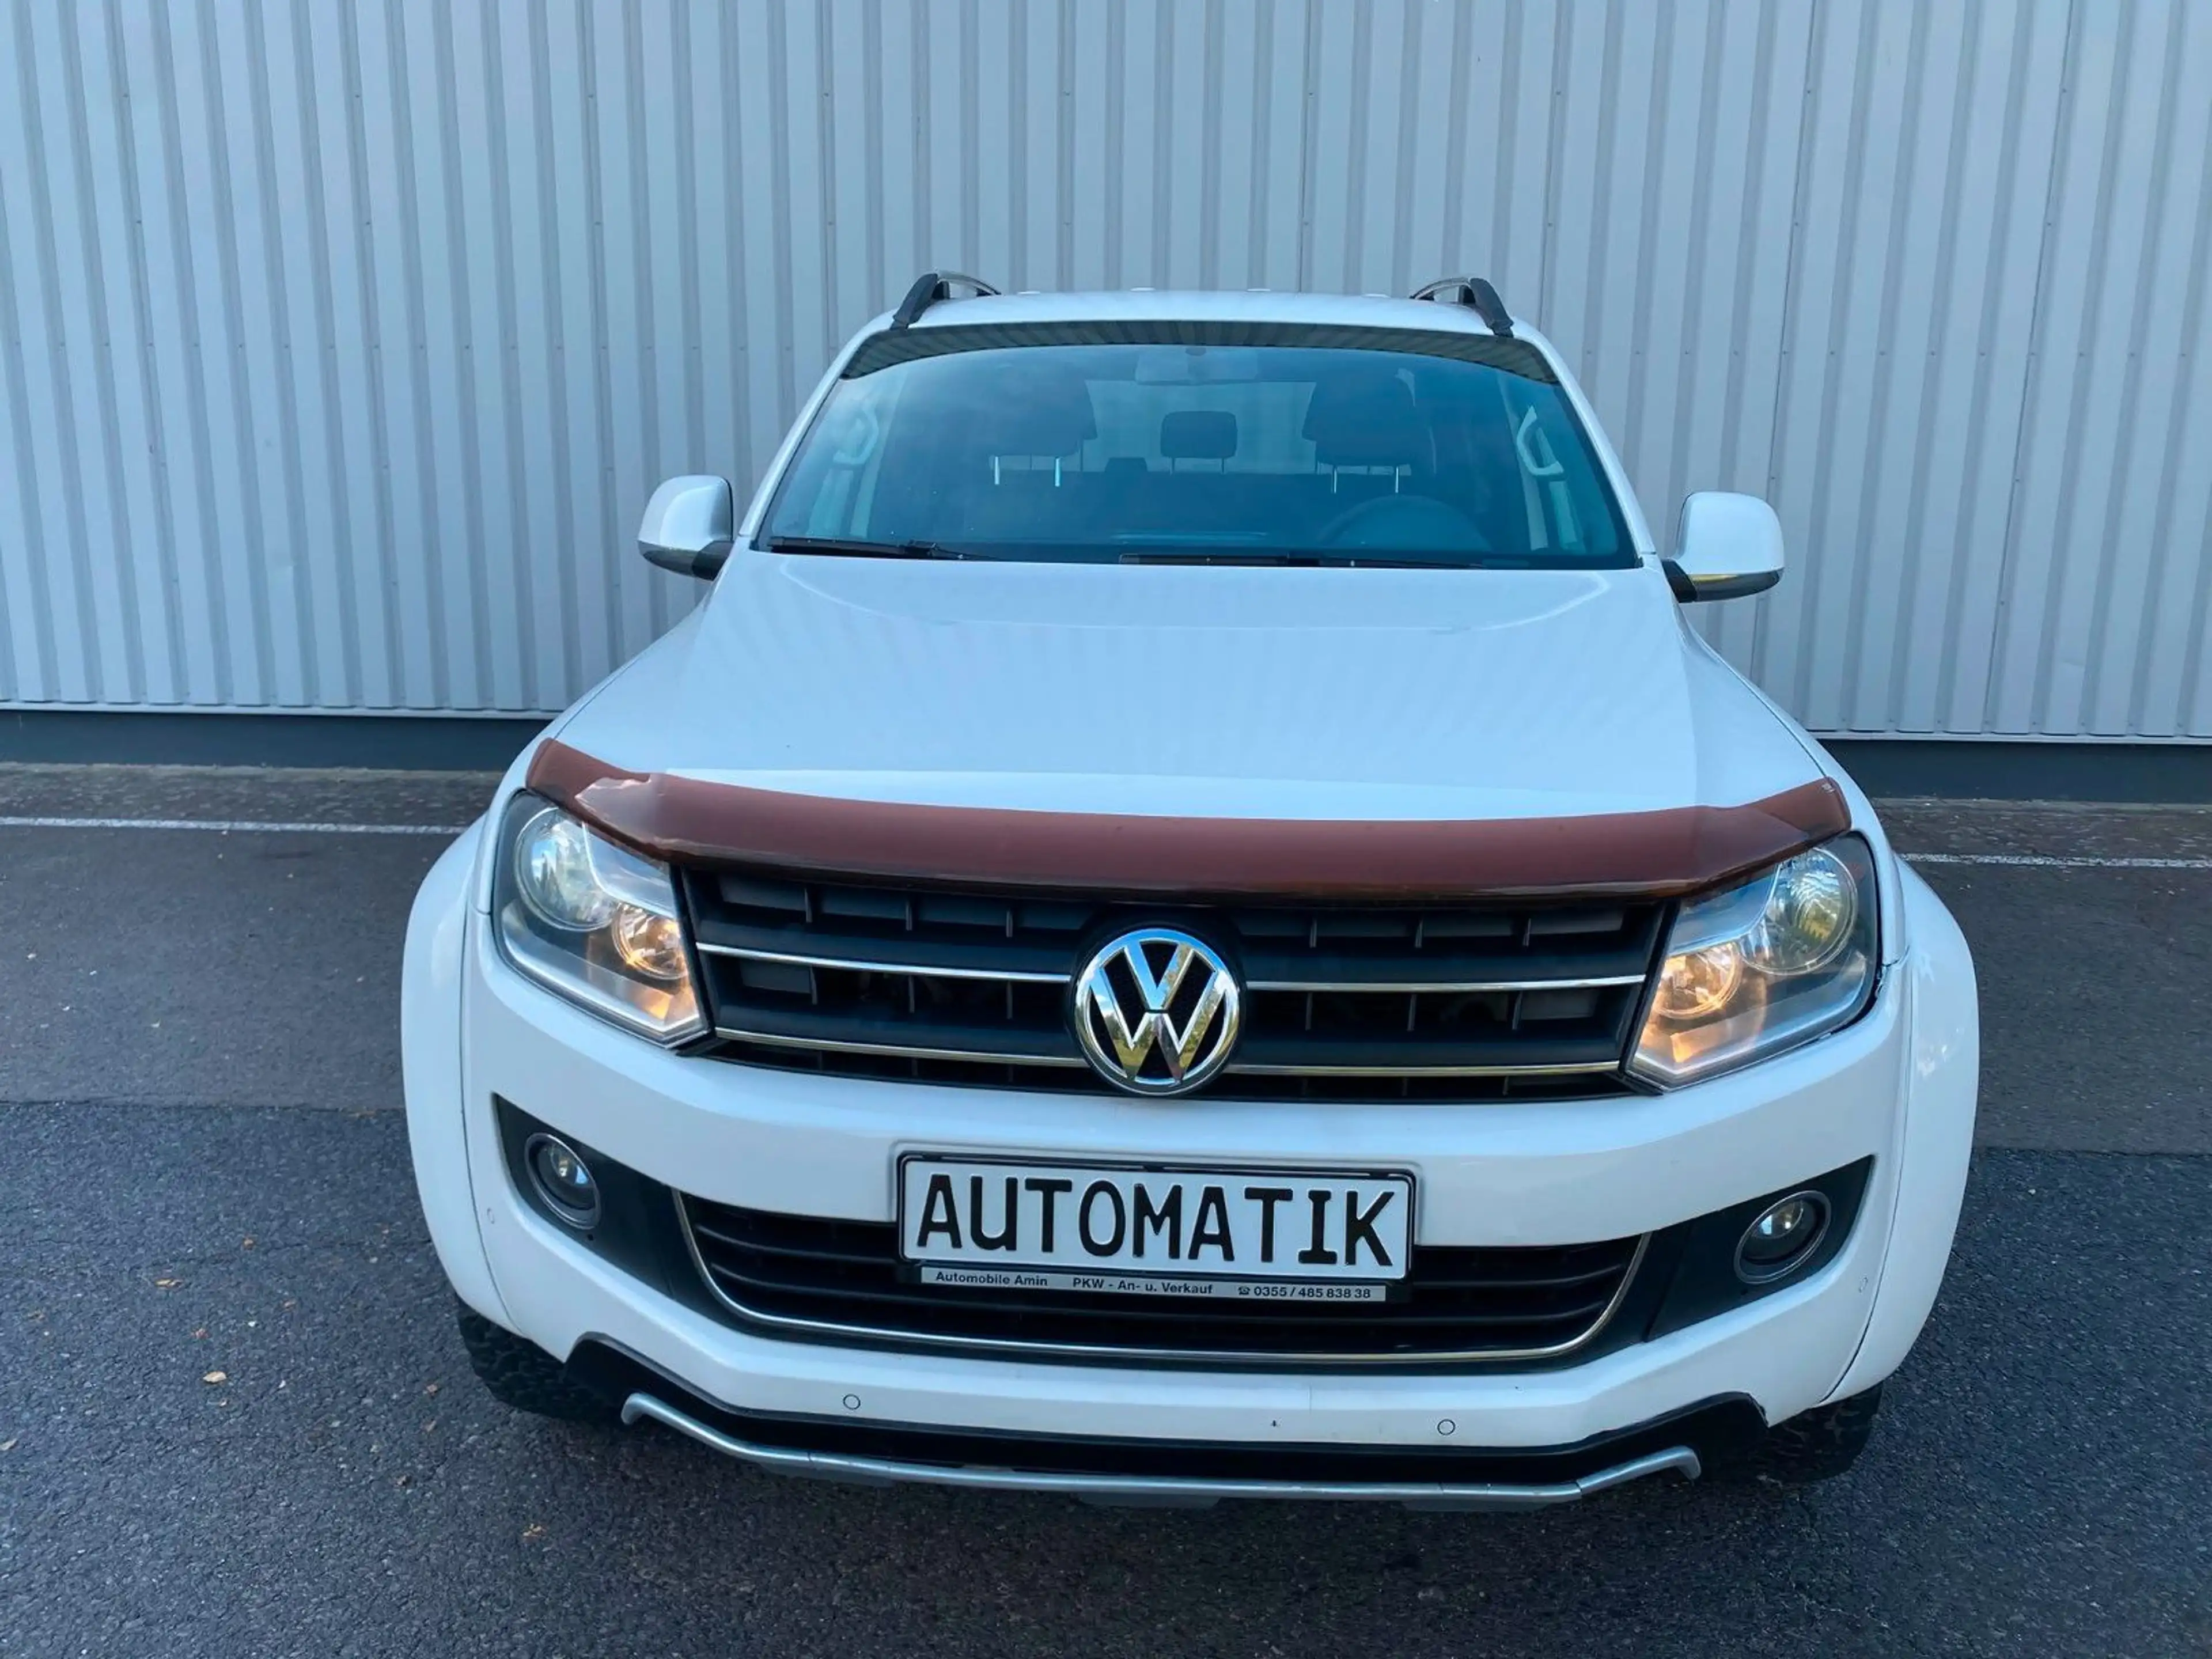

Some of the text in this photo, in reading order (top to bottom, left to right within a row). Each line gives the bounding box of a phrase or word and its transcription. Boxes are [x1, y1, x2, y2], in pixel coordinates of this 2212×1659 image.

[1081, 932, 1234, 1090] VW
[917, 1174, 1395, 1266] AUTOMATIK
[935, 1271, 1010, 1285] Automobile
[1014, 1274, 1048, 1286] Amin
[1073, 1277, 1104, 1289] PKW
[1118, 1279, 1140, 1291] An-
[1145, 1284, 1157, 1292] u.
[1161, 1282, 1214, 1294] Verkauf
[1254, 1286, 1287, 1296] 0355
[1298, 1288, 1323, 1297] 485
[1326, 1288, 1351, 1298] 838
[1354, 1289, 1371, 1298] 38
